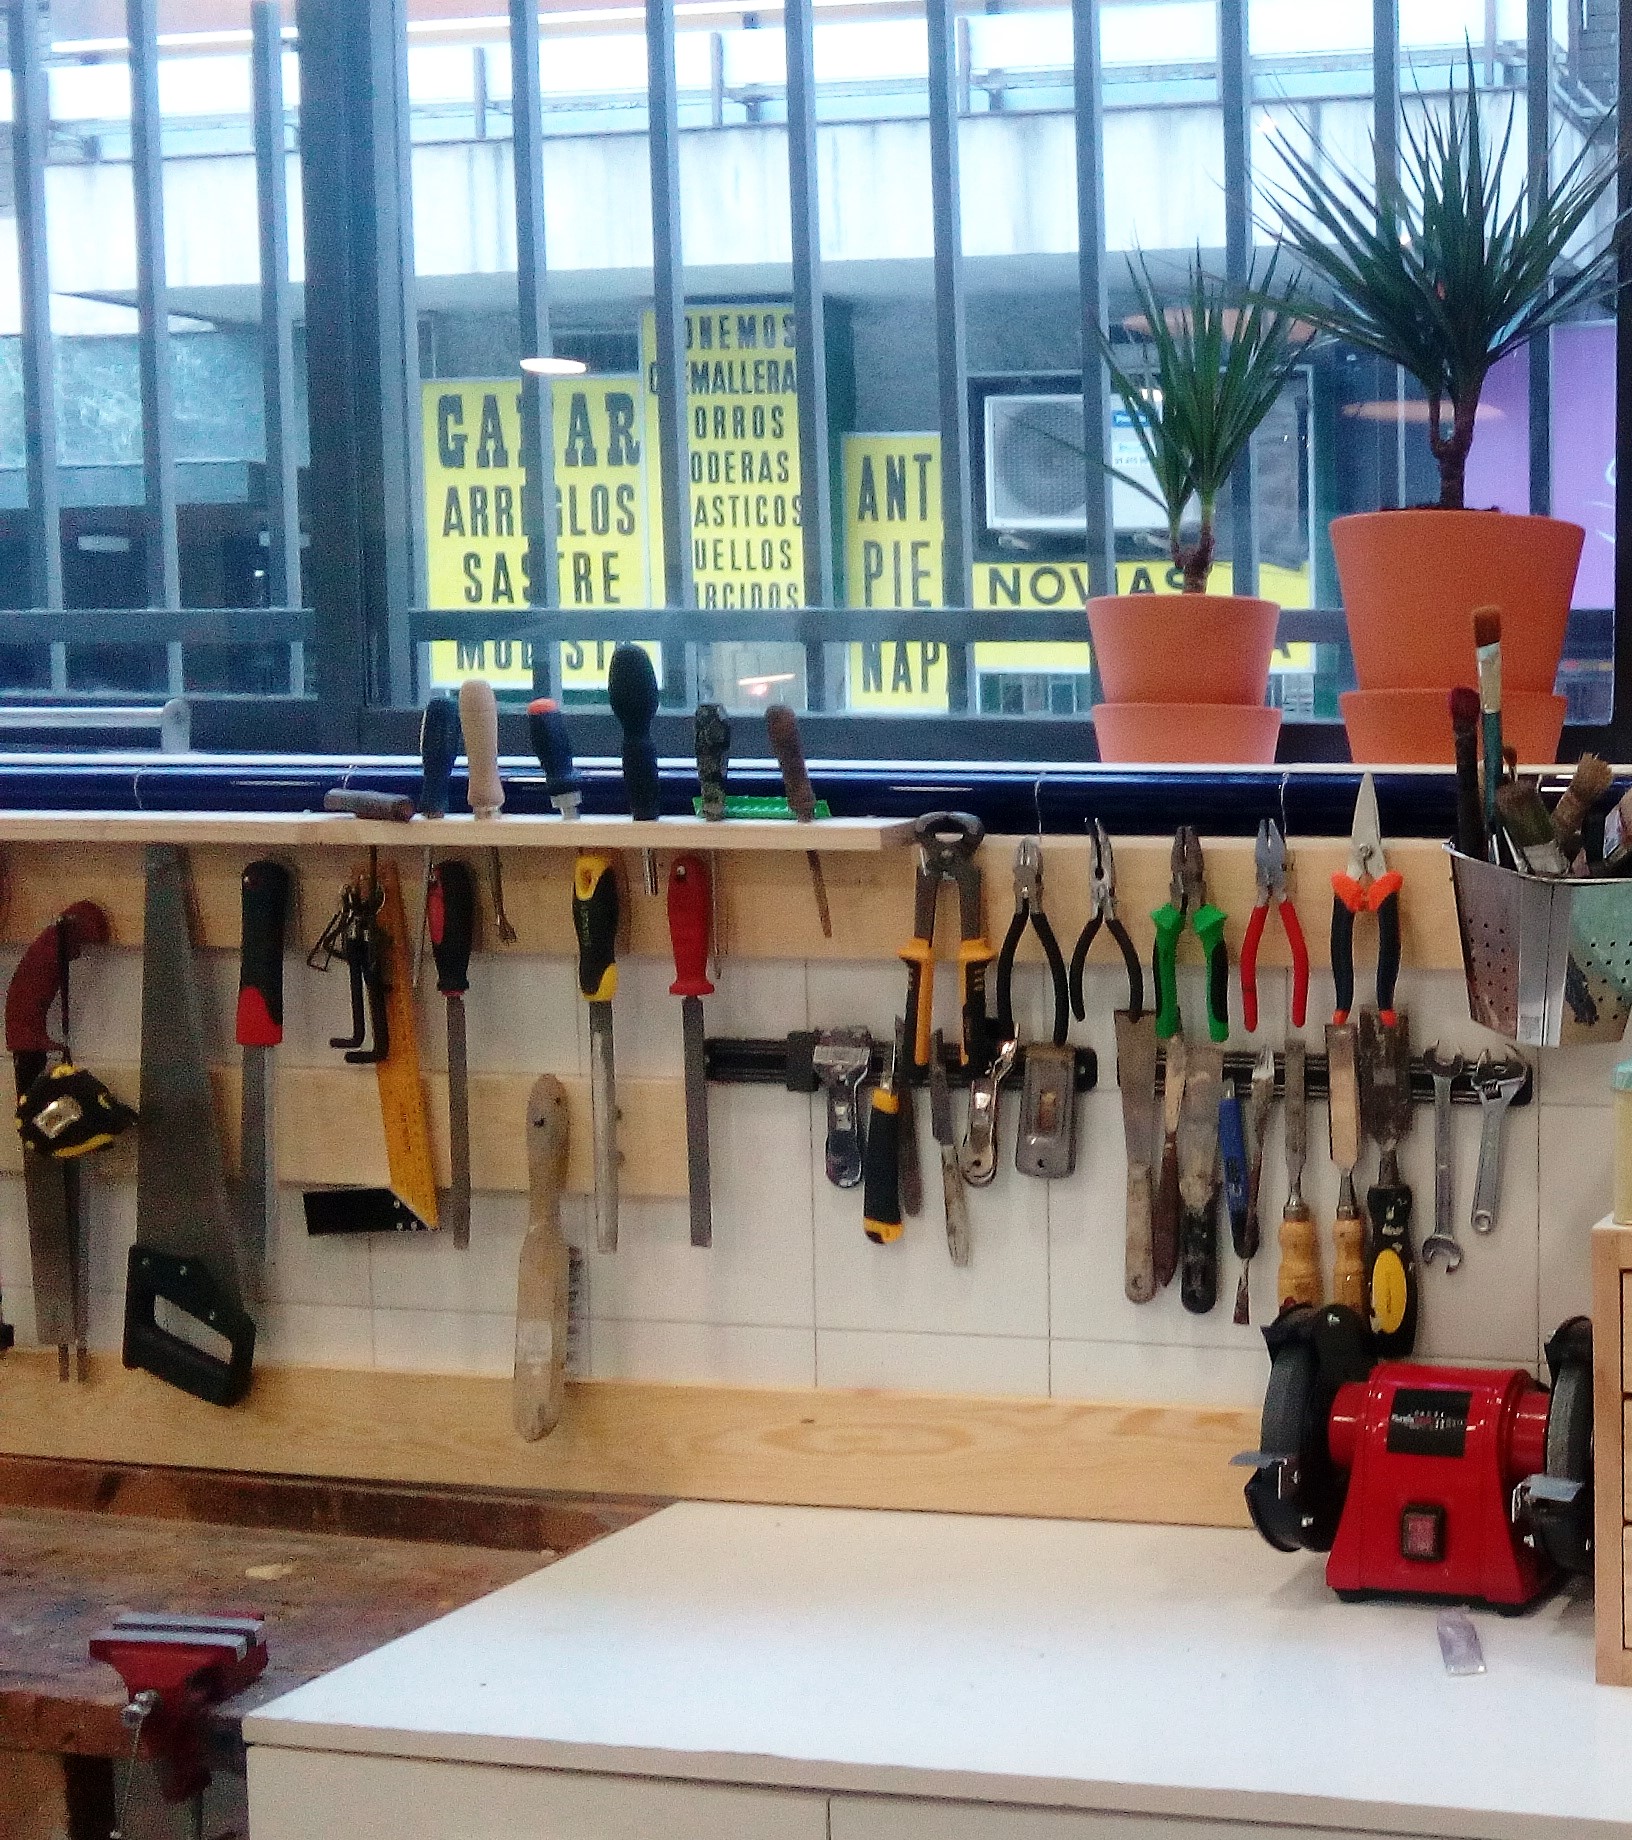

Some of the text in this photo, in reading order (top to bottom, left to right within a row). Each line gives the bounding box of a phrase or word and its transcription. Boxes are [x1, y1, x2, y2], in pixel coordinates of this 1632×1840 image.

[684, 314, 797, 348] ONEMOS
[437, 390, 641, 469] GAAR
[694, 404, 785, 439] ORROS
[691, 450, 790, 483] ODERAS
[858, 453, 933, 521] ANT
[443, 482, 636, 537] ARRLOS
[693, 494, 803, 527] ASTICOS
[694, 538, 792, 570] UELLOS
[864, 541, 933, 607] PIE
[988, 565, 1185, 606] NOVA
[695, 582, 799, 609] RCIDOS
[862, 641, 941, 693] NAP
